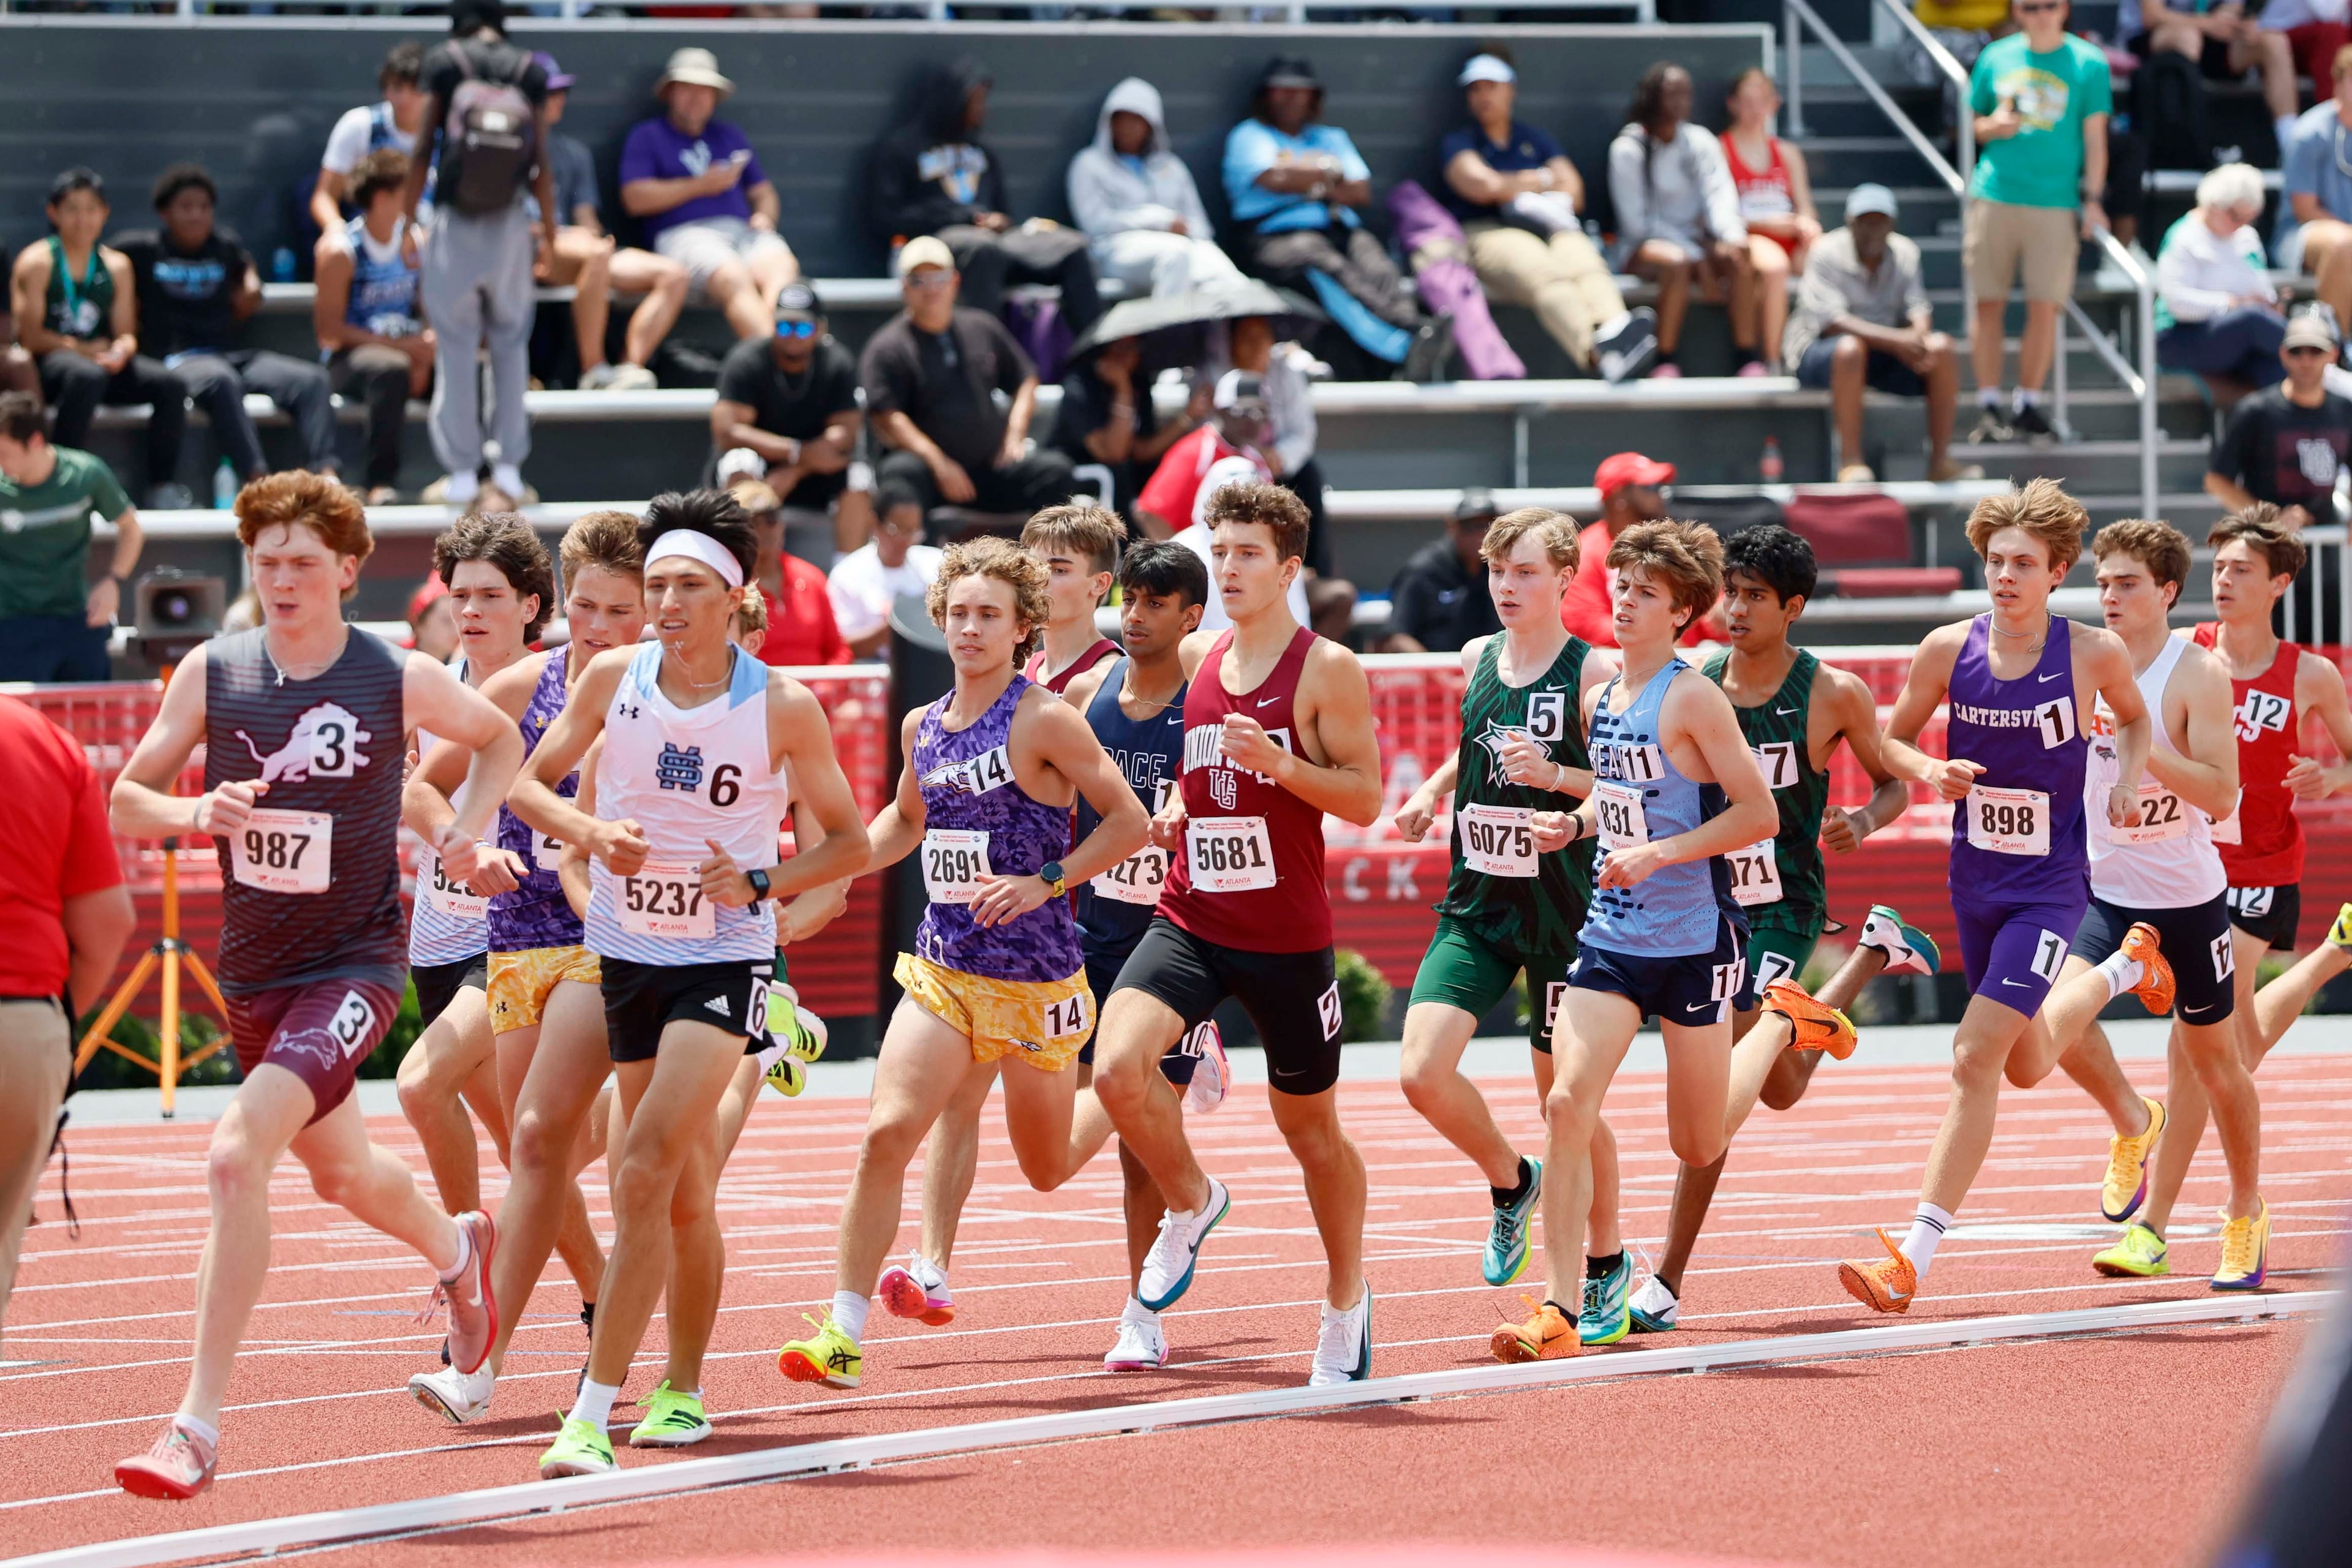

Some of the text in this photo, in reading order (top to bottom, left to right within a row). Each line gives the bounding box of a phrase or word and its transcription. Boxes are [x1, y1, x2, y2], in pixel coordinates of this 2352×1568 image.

[1531, 696, 1556, 737] 5
[2043, 704, 2064, 743] 1
[2250, 694, 2282, 728] 12
[315, 722, 345, 771] 3
[1624, 747, 1653, 780] 11
[710, 763, 742, 807] 6
[970, 749, 1006, 791] 14
[1764, 746, 1788, 786] 7
[1600, 800, 1634, 837] 831
[1981, 803, 2035, 835] 898
[246, 829, 311, 870] 987
[1196, 835, 1266, 872] 5681
[1468, 820, 1532, 858] 6075
[929, 848, 982, 883] 2691
[1491, 862, 1514, 871] ATLANTA
[456, 903, 481, 912] ATLANTA
[626, 876, 704, 916] 5237
[1762, 955, 1790, 992] 7
[2043, 938, 2059, 977] 1
[2216, 939, 2230, 974] 4
[1717, 962, 1740, 998] 11
[338, 1000, 367, 1045] 3
[752, 985, 766, 1032] 6
[1048, 997, 1082, 1035] 14
[1323, 990, 1340, 1036] 2
[1186, 1023, 1208, 1056] 10
